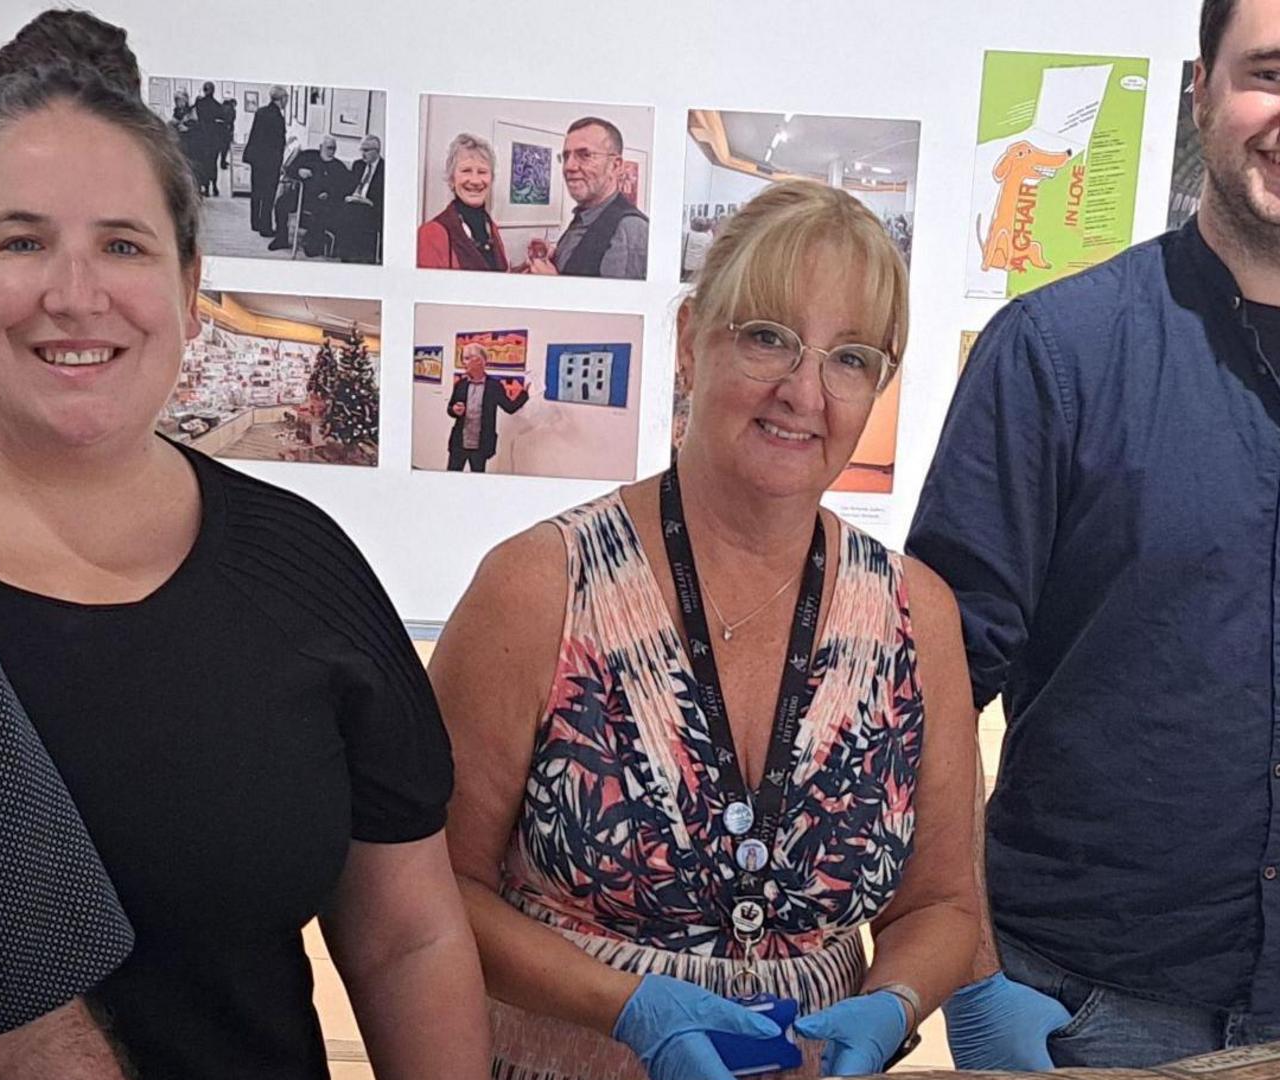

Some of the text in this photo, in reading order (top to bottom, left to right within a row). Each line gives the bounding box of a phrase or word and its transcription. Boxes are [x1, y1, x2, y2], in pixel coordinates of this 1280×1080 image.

[1065, 165, 1085, 227] IN LOVE
[1010, 184, 1038, 273] A CHAIR
[761, 815, 772, 842] GYPT
